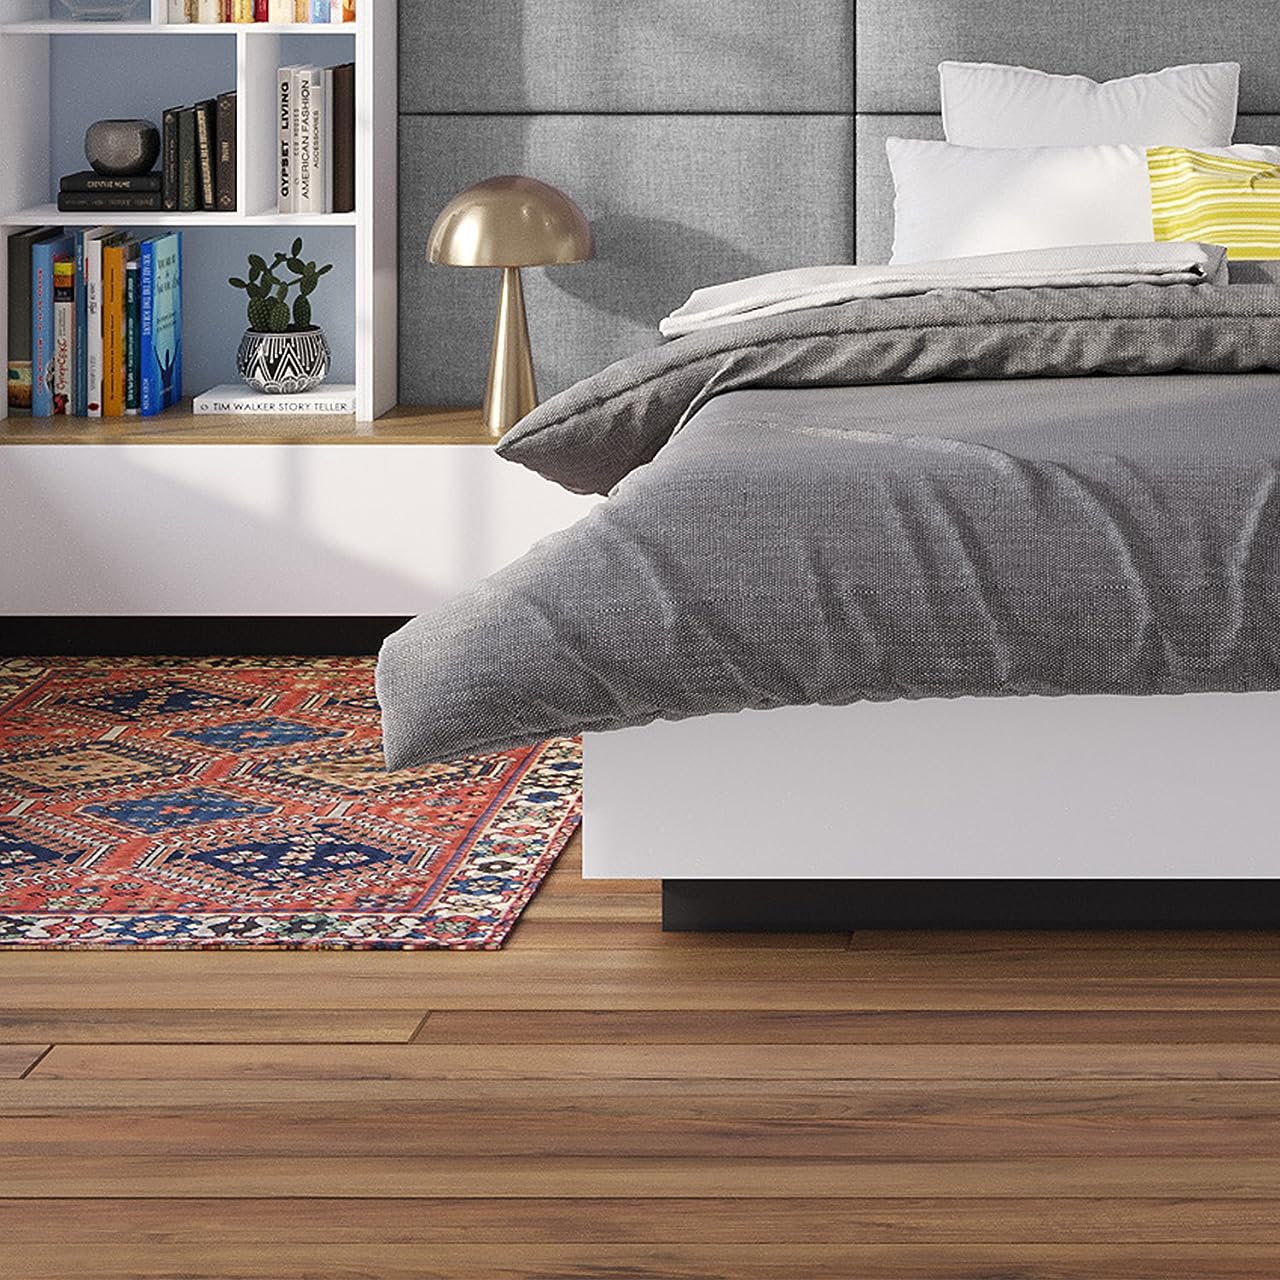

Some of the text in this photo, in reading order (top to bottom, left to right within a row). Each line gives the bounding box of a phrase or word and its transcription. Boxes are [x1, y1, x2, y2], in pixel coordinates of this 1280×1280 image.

[281, 82, 289, 197] GYPSET LIVING
[301, 80, 310, 199] AMERICAN FASHION
